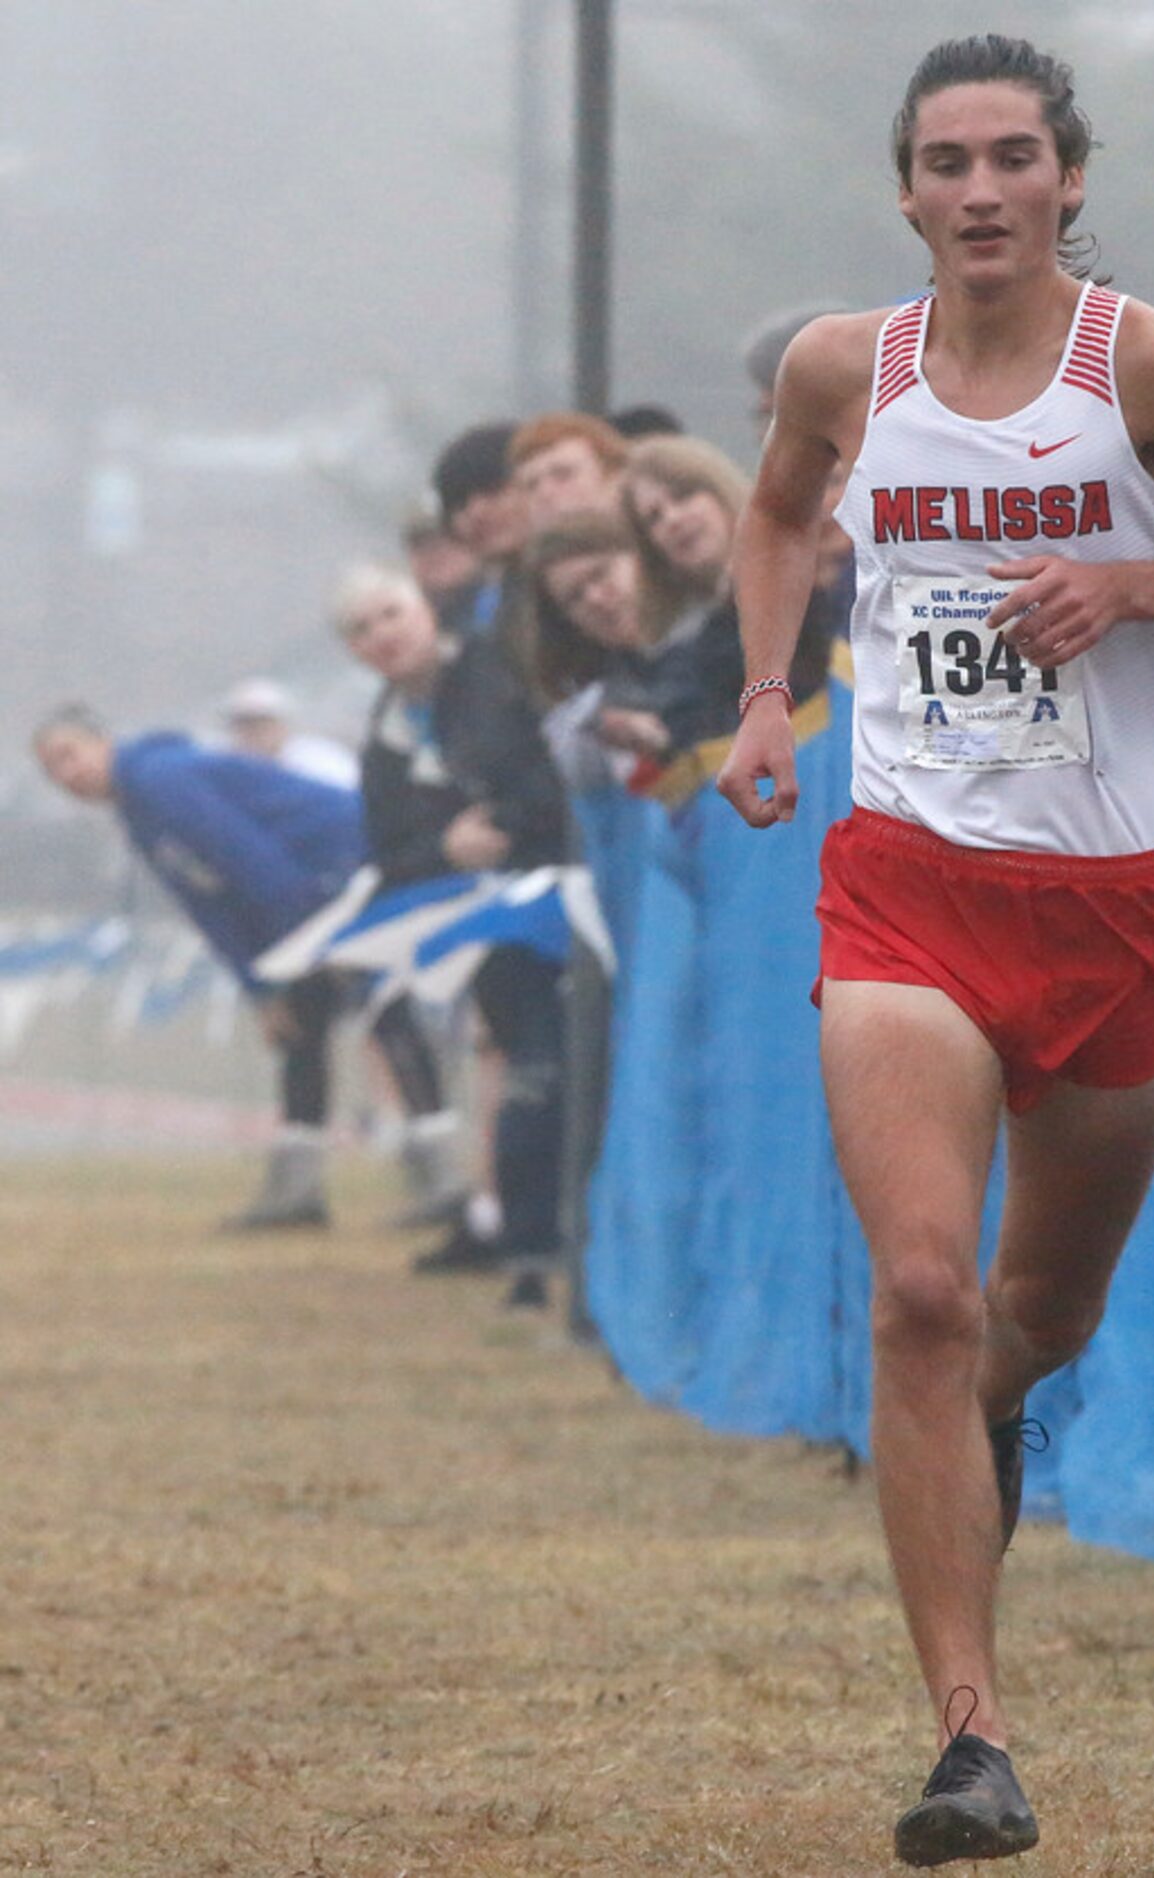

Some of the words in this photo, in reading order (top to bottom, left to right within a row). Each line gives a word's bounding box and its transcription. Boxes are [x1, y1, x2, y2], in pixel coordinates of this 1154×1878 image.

[871, 480, 1113, 544] MELISSA
[930, 589, 954, 602] UIL
[911, 605, 929, 618] XC
